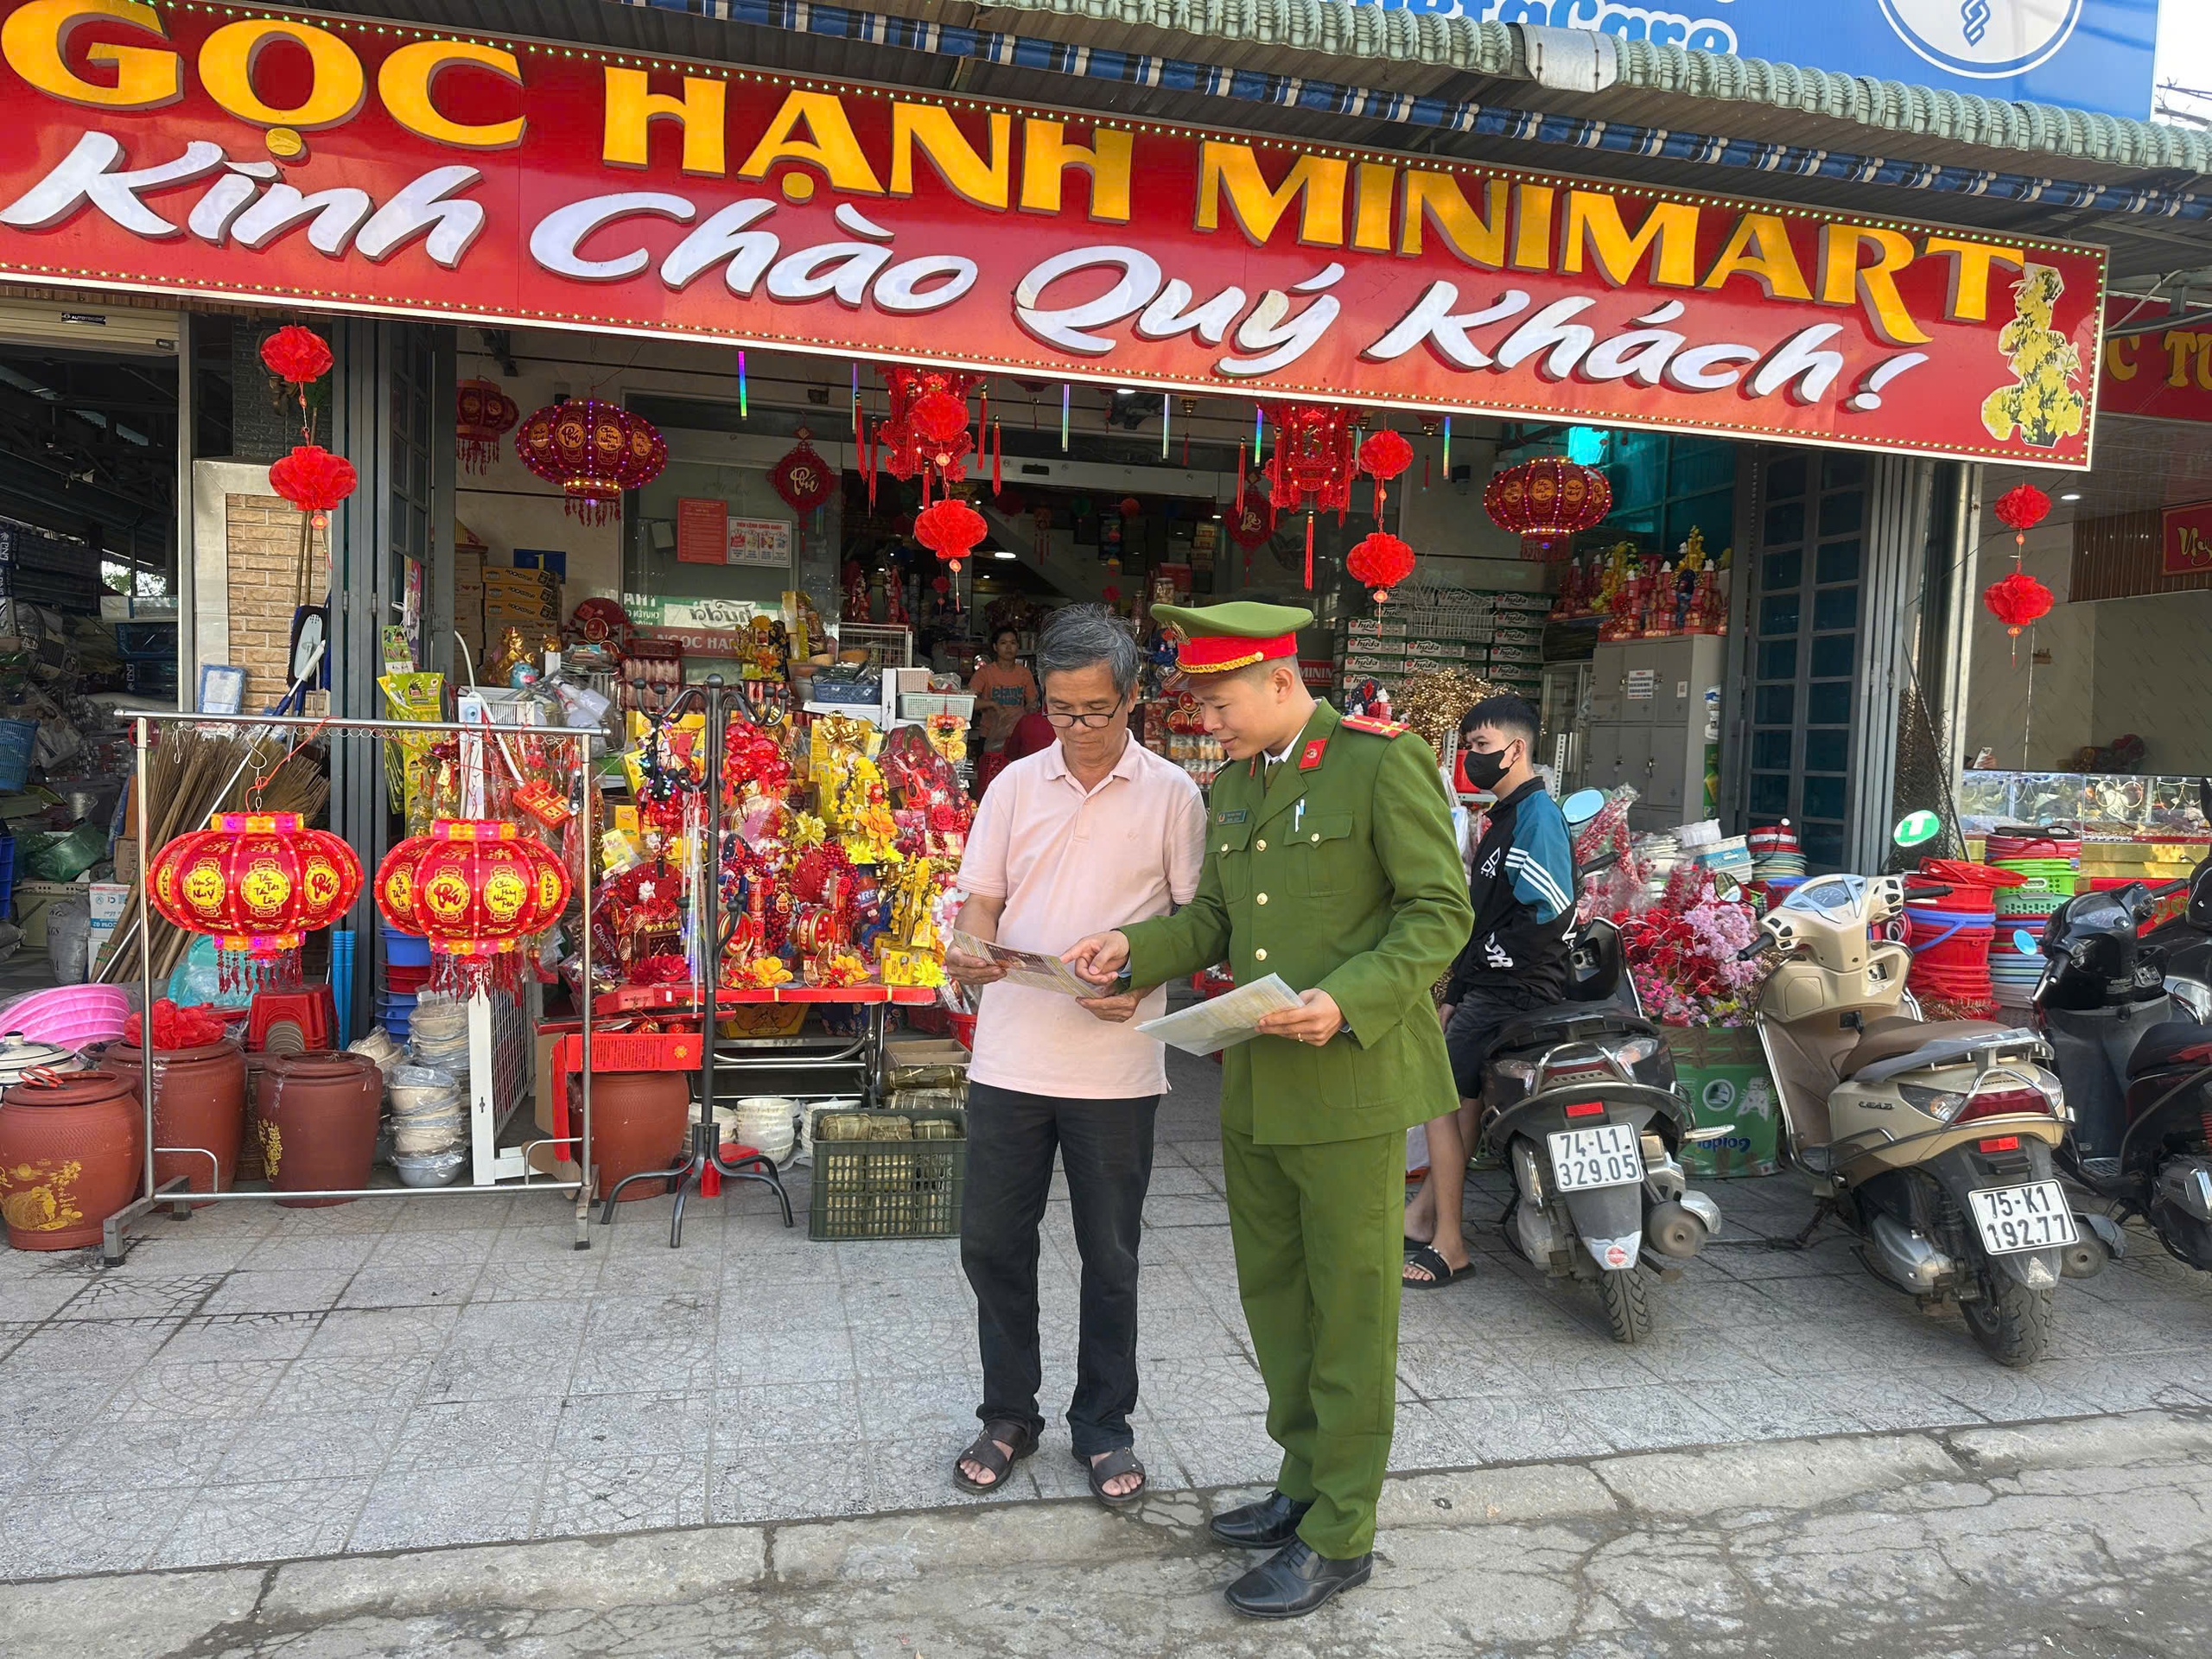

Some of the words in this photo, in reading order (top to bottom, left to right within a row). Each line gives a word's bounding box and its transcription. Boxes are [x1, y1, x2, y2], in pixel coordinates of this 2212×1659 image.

[0, 0, 526, 162] GỌC
[603, 66, 1134, 224] HẠNH
[1194, 139, 2025, 345] MINIMART
[529, 192, 977, 313] Chào
[1014, 245, 1345, 377] Quý
[1361, 280, 1929, 411] Khách!
[1504, 594, 1528, 606] huda
[1504, 612, 1527, 624] huda
[1503, 630, 1526, 641] huda
[1357, 638, 1380, 650] huda
[1416, 641, 1440, 653] huda
[1499, 647, 1522, 658] huda
[1355, 656, 1378, 669] huda
[1414, 659, 1438, 671] huda
[1497, 664, 1519, 677] huda
[1559, 1154, 1637, 1187] 329.05
[1983, 1185, 2052, 1218] 75-K1
[1986, 1213, 2068, 1250] 192.77
